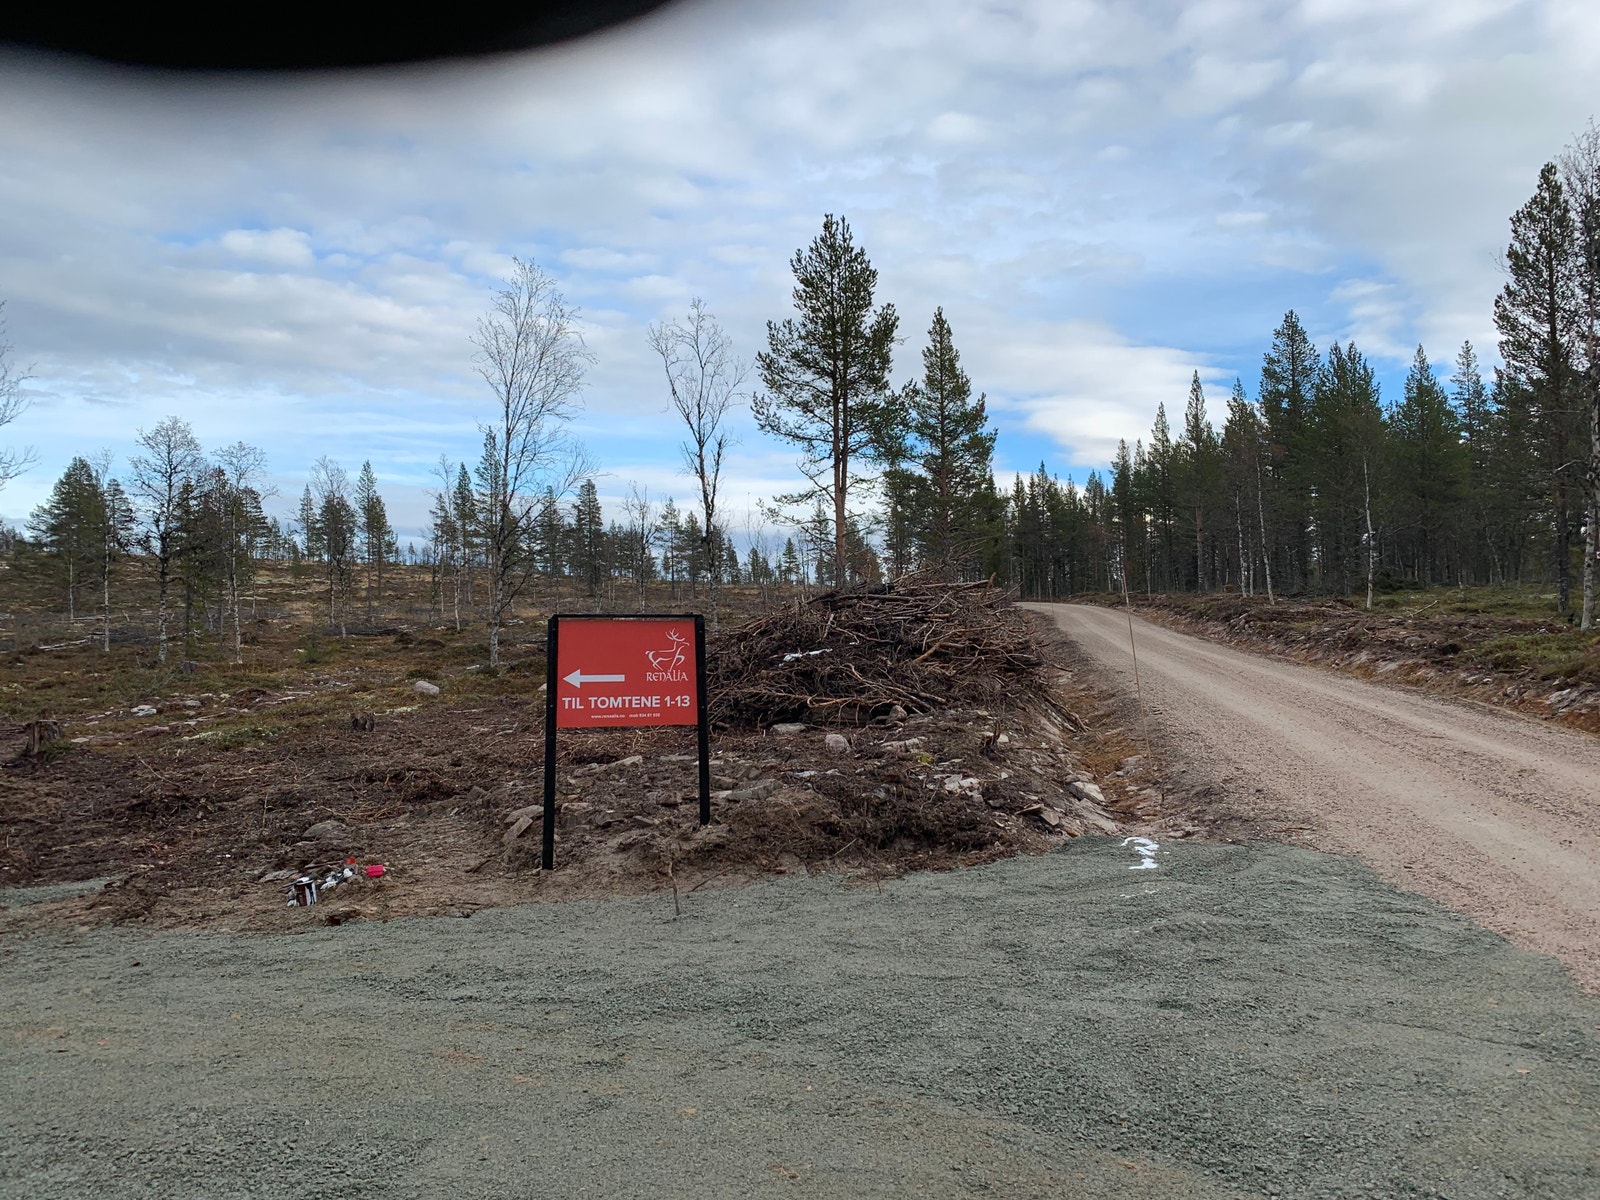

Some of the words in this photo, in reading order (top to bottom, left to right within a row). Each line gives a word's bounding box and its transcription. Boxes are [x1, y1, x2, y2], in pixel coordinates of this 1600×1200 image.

[562, 697, 584, 709] TIL
[588, 696, 661, 709] TOMTENE
[664, 695, 690, 707] 1-13
